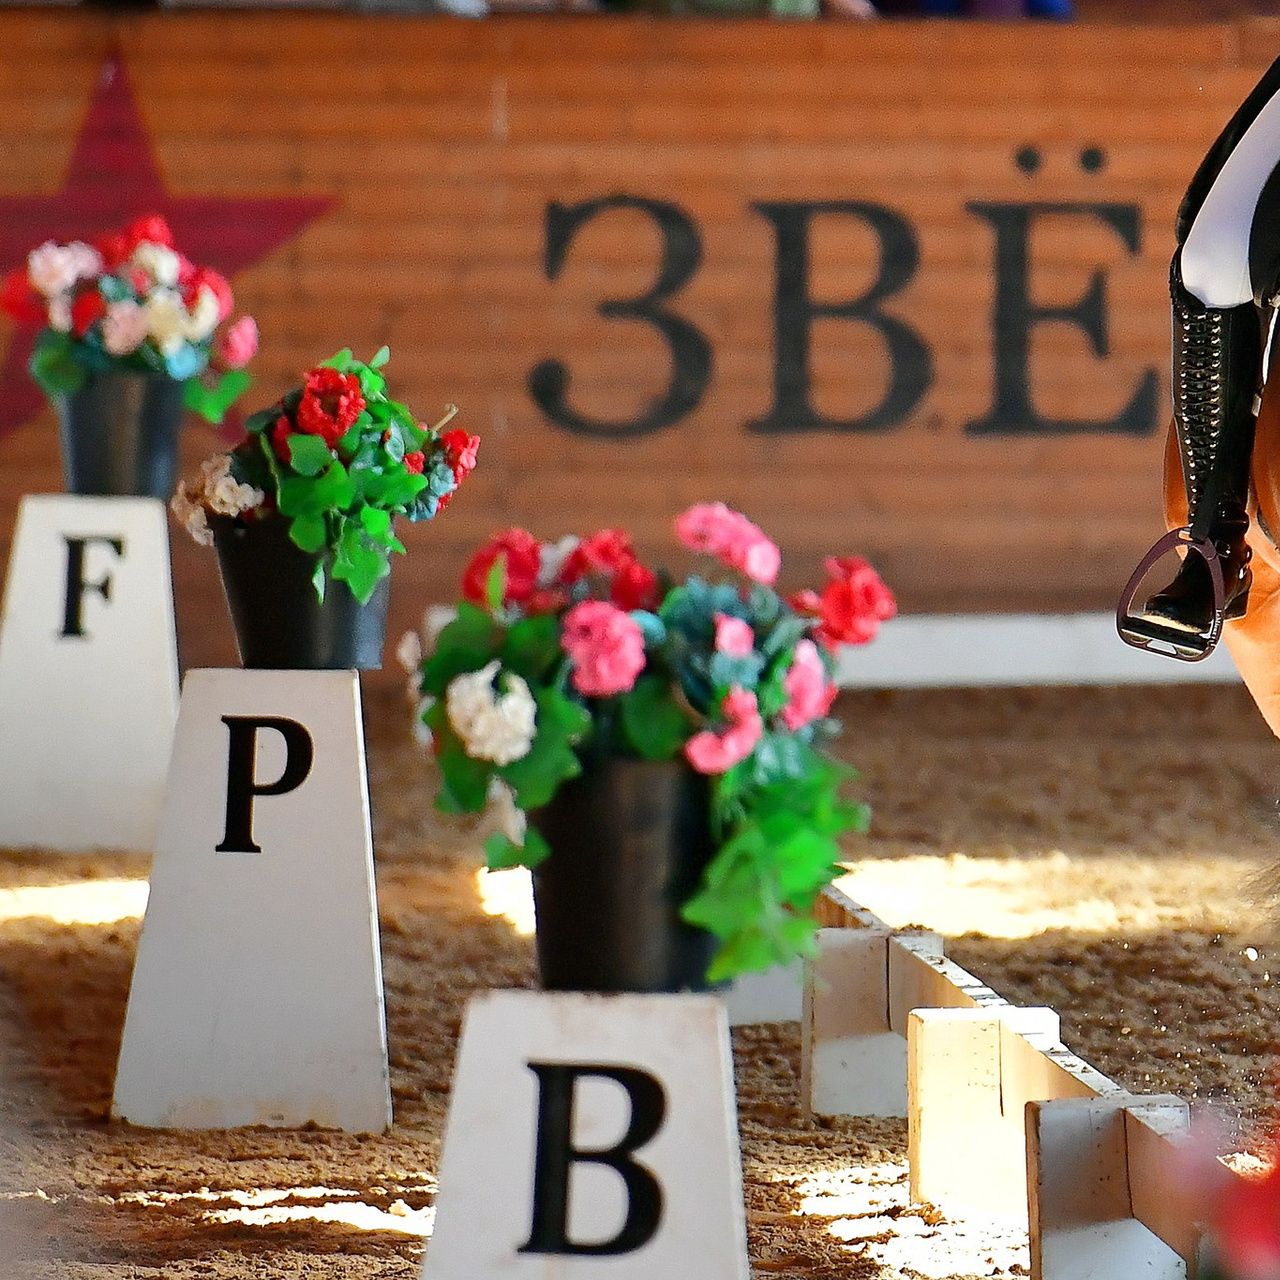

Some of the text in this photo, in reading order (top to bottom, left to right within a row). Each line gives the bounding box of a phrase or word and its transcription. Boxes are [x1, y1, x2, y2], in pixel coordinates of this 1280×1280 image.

[61, 536, 124, 639] F
[214, 715, 314, 854] P
[516, 1061, 668, 1257] B
